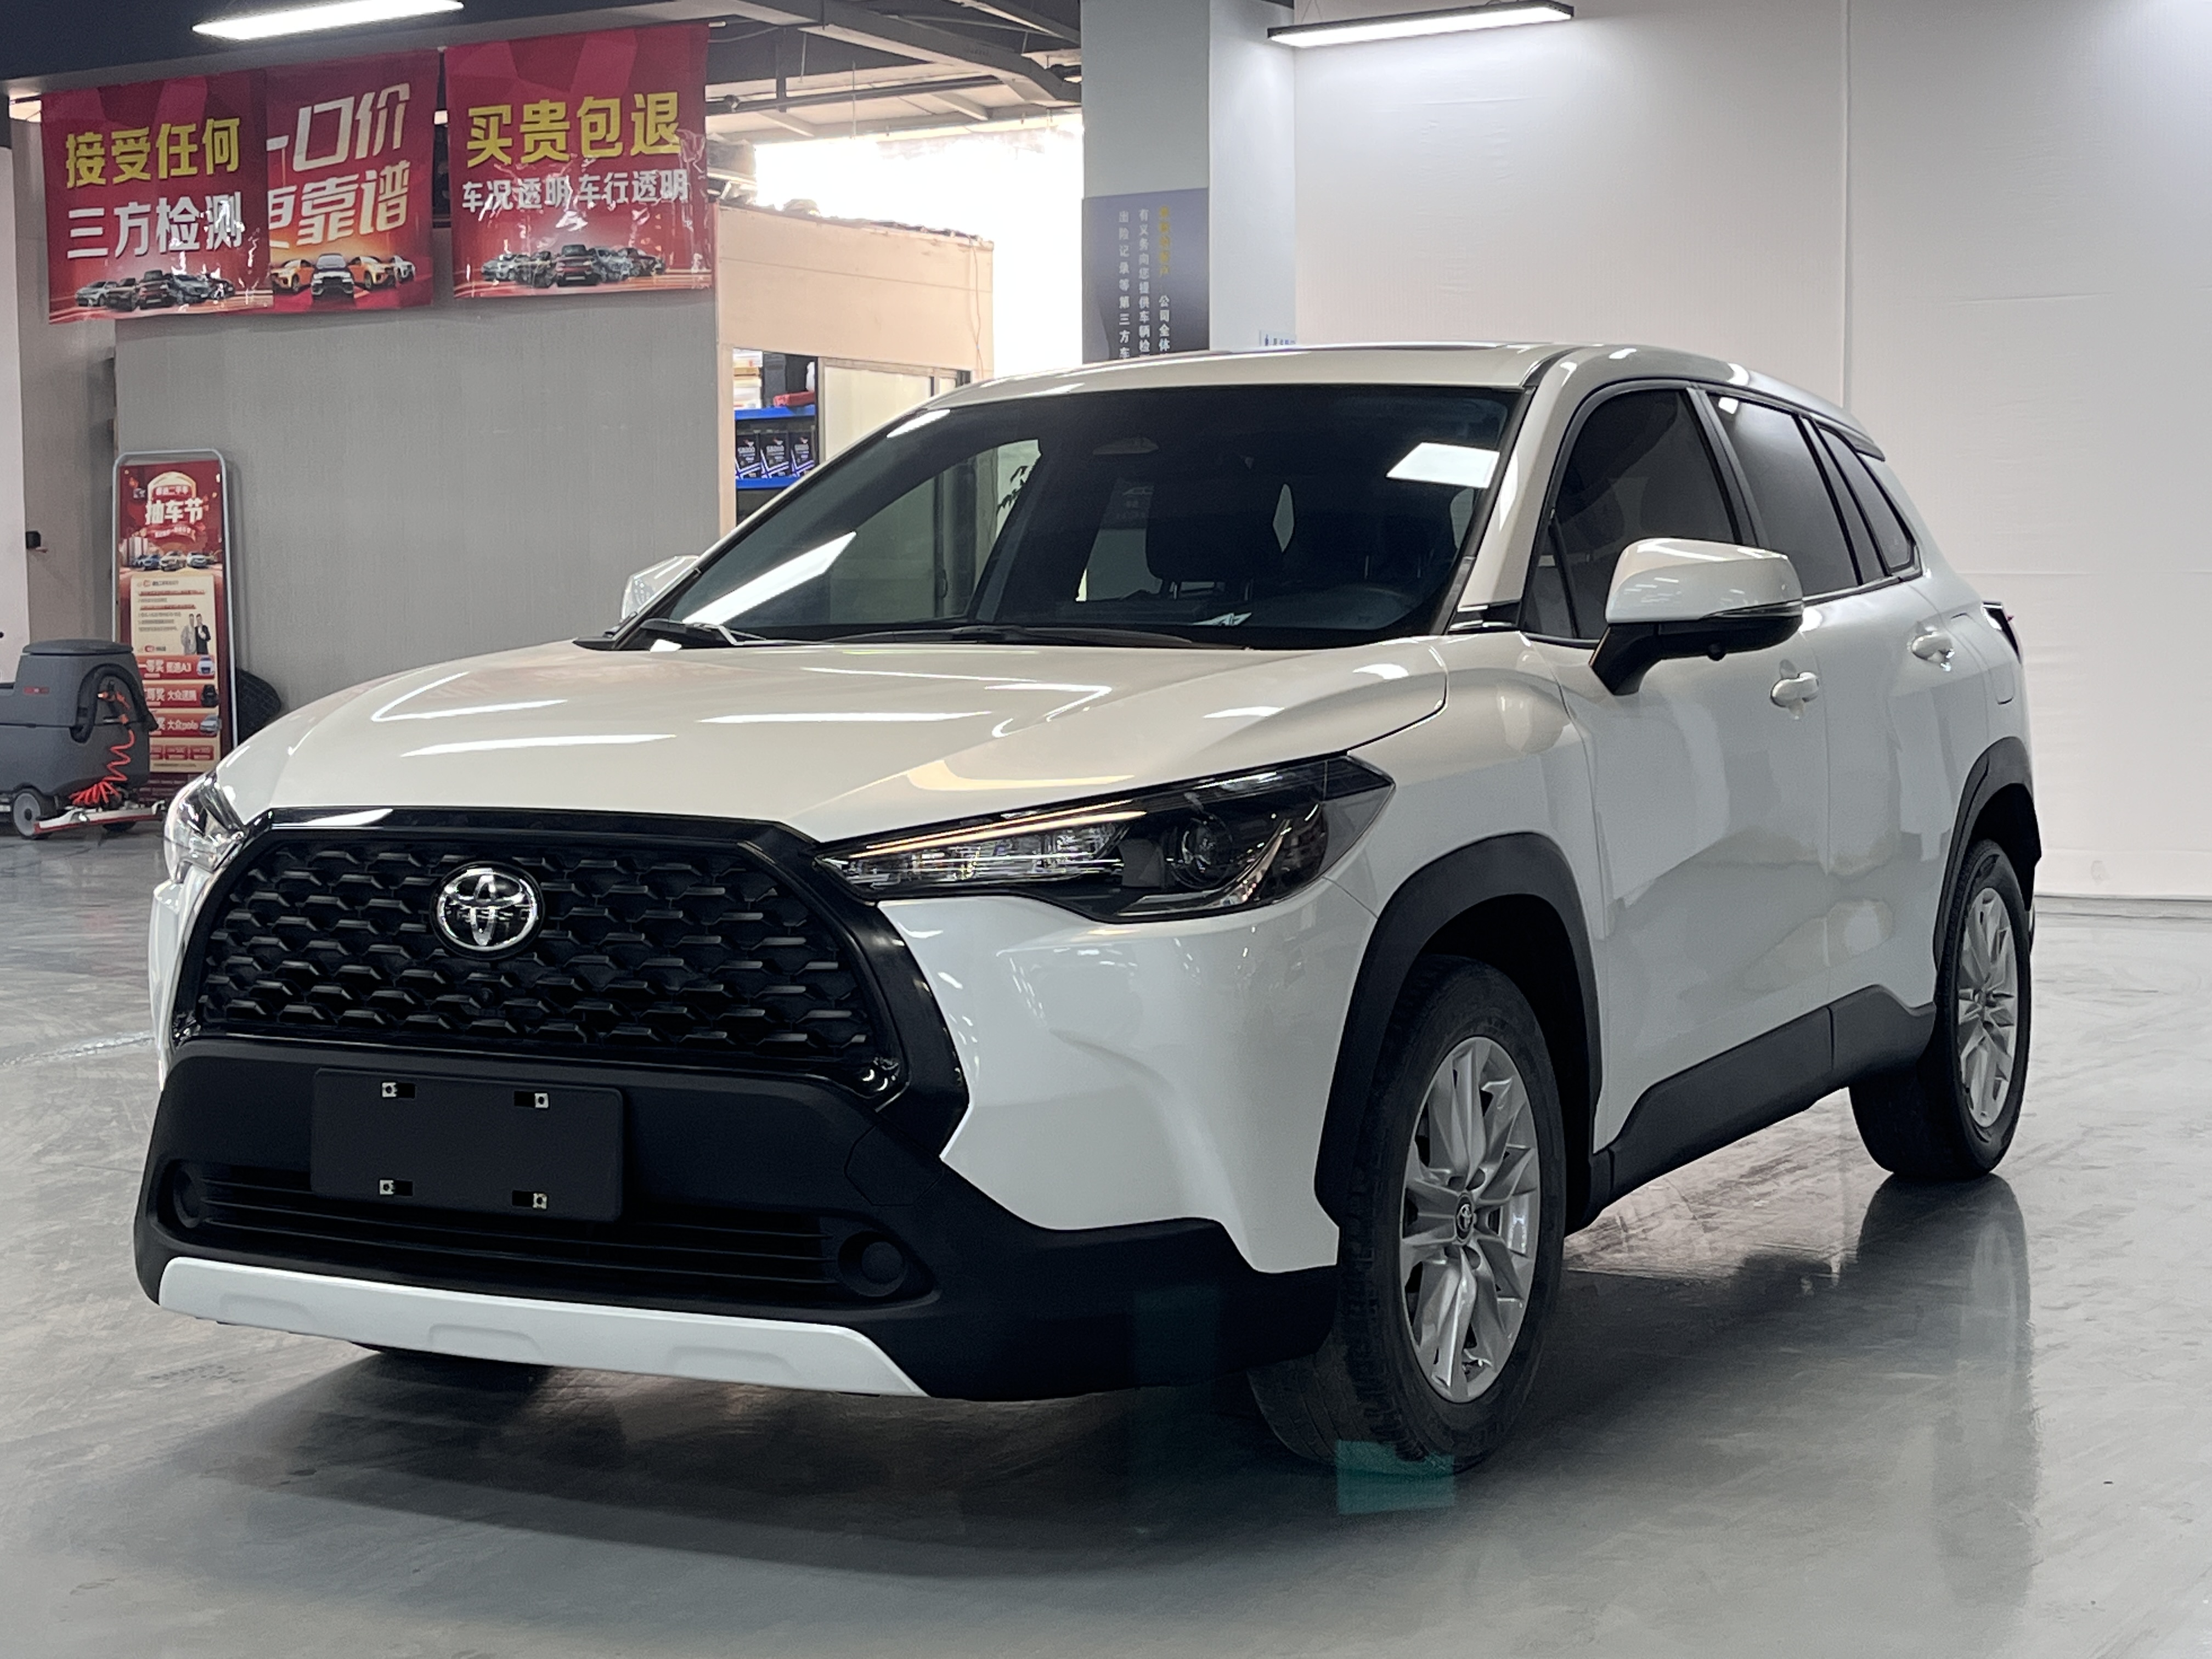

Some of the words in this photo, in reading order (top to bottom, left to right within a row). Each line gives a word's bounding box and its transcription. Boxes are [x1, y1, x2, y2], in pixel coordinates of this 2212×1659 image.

[66, 117, 240, 188] 接受任何
[266, 83, 410, 172] 一口价
[467, 92, 682, 167] 买贵包退
[67, 191, 243, 258] 三方检测
[462, 176, 571, 213] 车况透明
[578, 169, 688, 208] 车行透明
[1139, 208, 1150, 356] 有义务向您提供车辆检
